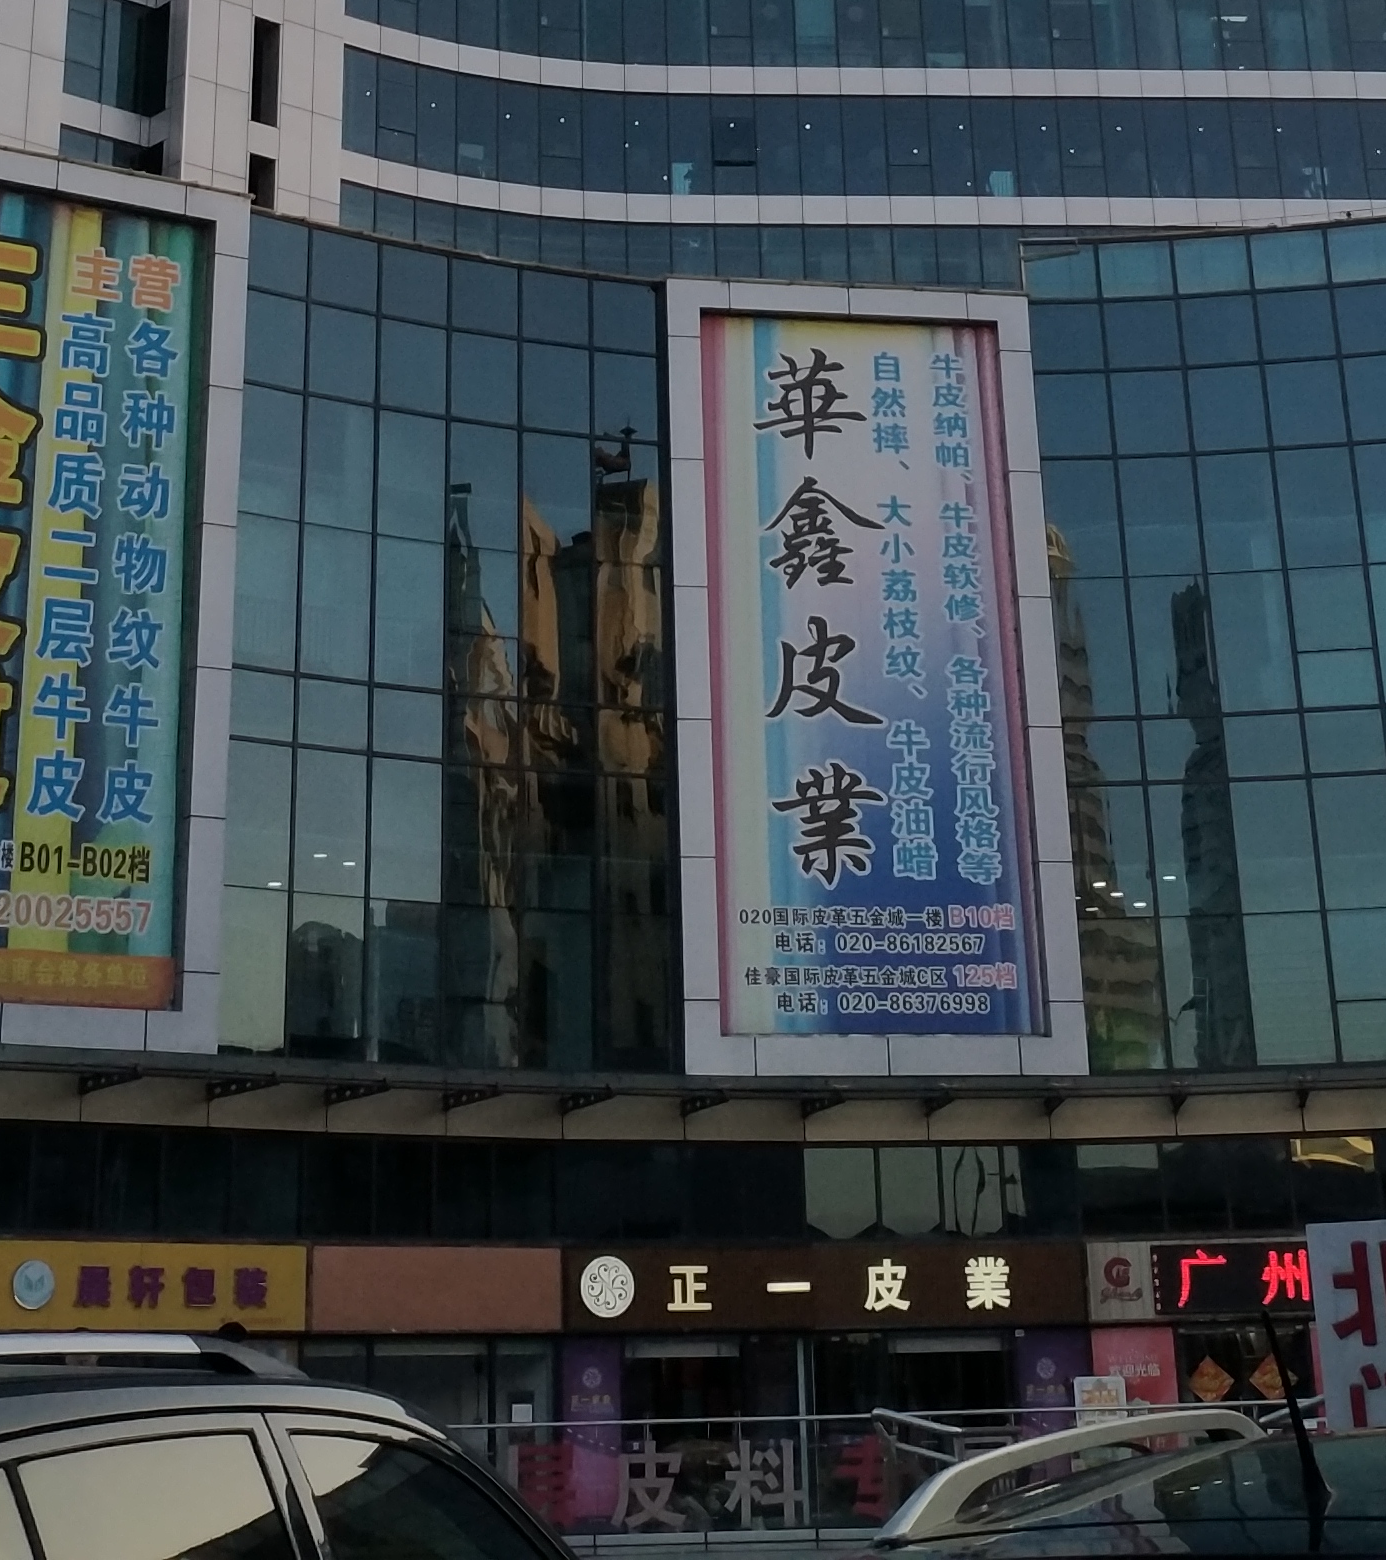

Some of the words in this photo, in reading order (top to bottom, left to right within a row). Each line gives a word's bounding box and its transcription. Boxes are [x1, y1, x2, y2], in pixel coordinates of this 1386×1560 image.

[70, 244, 183, 313] 主营
[24, 311, 115, 825] 高品质二层牛皮
[98, 318, 180, 828] 各种动物纹牛皮
[752, 347, 888, 889] 華鑫皮業
[666, 1255, 1012, 1313] 正一皮業
[1178, 1247, 1312, 1308] 广州
